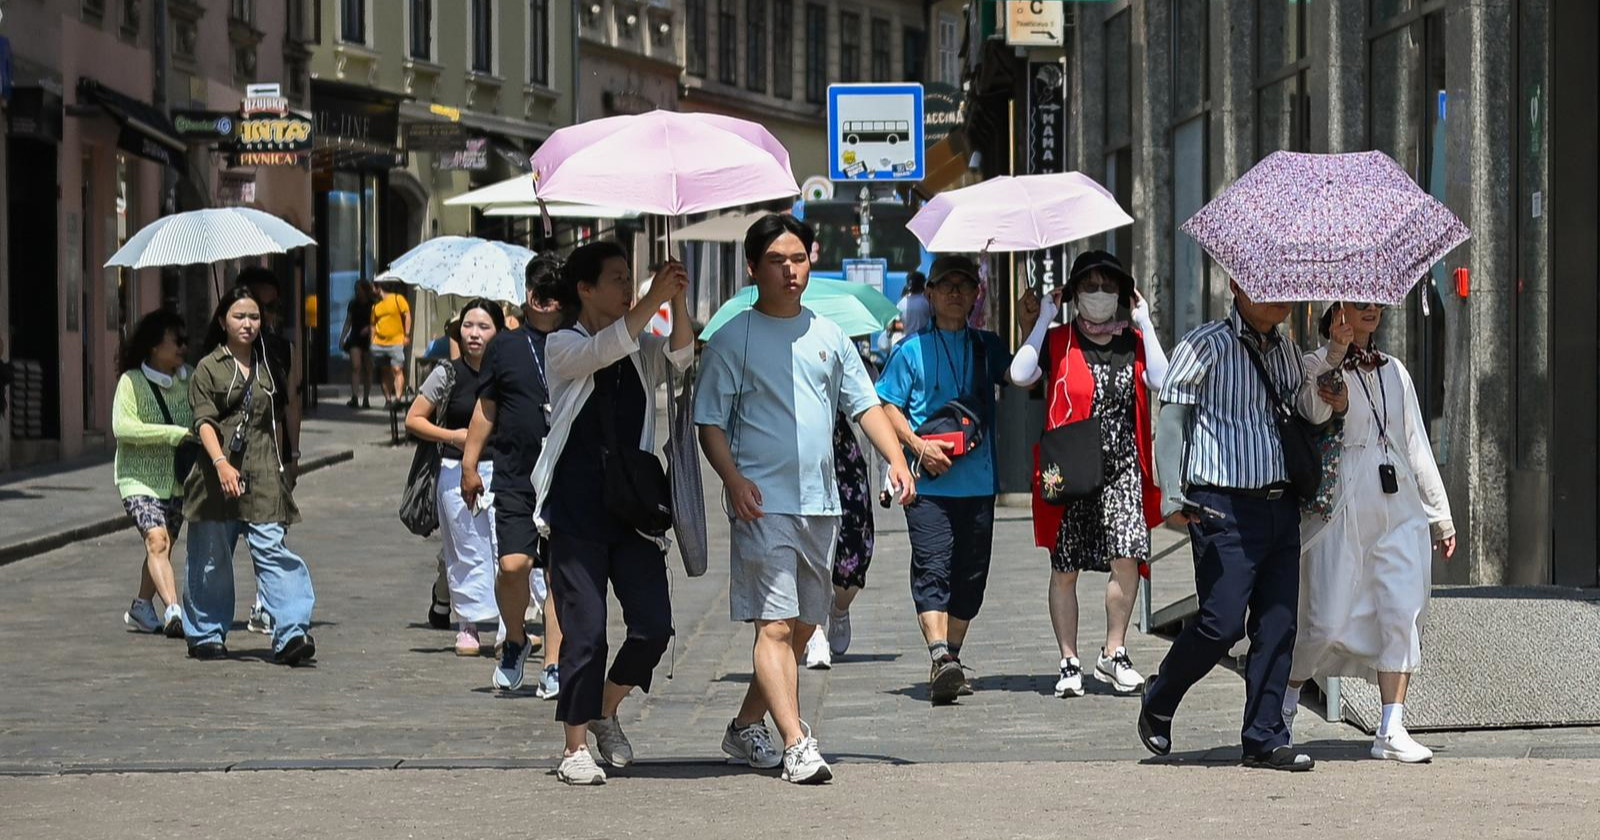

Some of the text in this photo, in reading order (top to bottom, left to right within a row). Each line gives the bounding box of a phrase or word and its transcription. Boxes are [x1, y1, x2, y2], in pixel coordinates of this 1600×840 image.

[924, 109, 965, 124] ACCINA
[235, 119, 311, 144] INTA
[1042, 113, 1055, 161] MAMA
